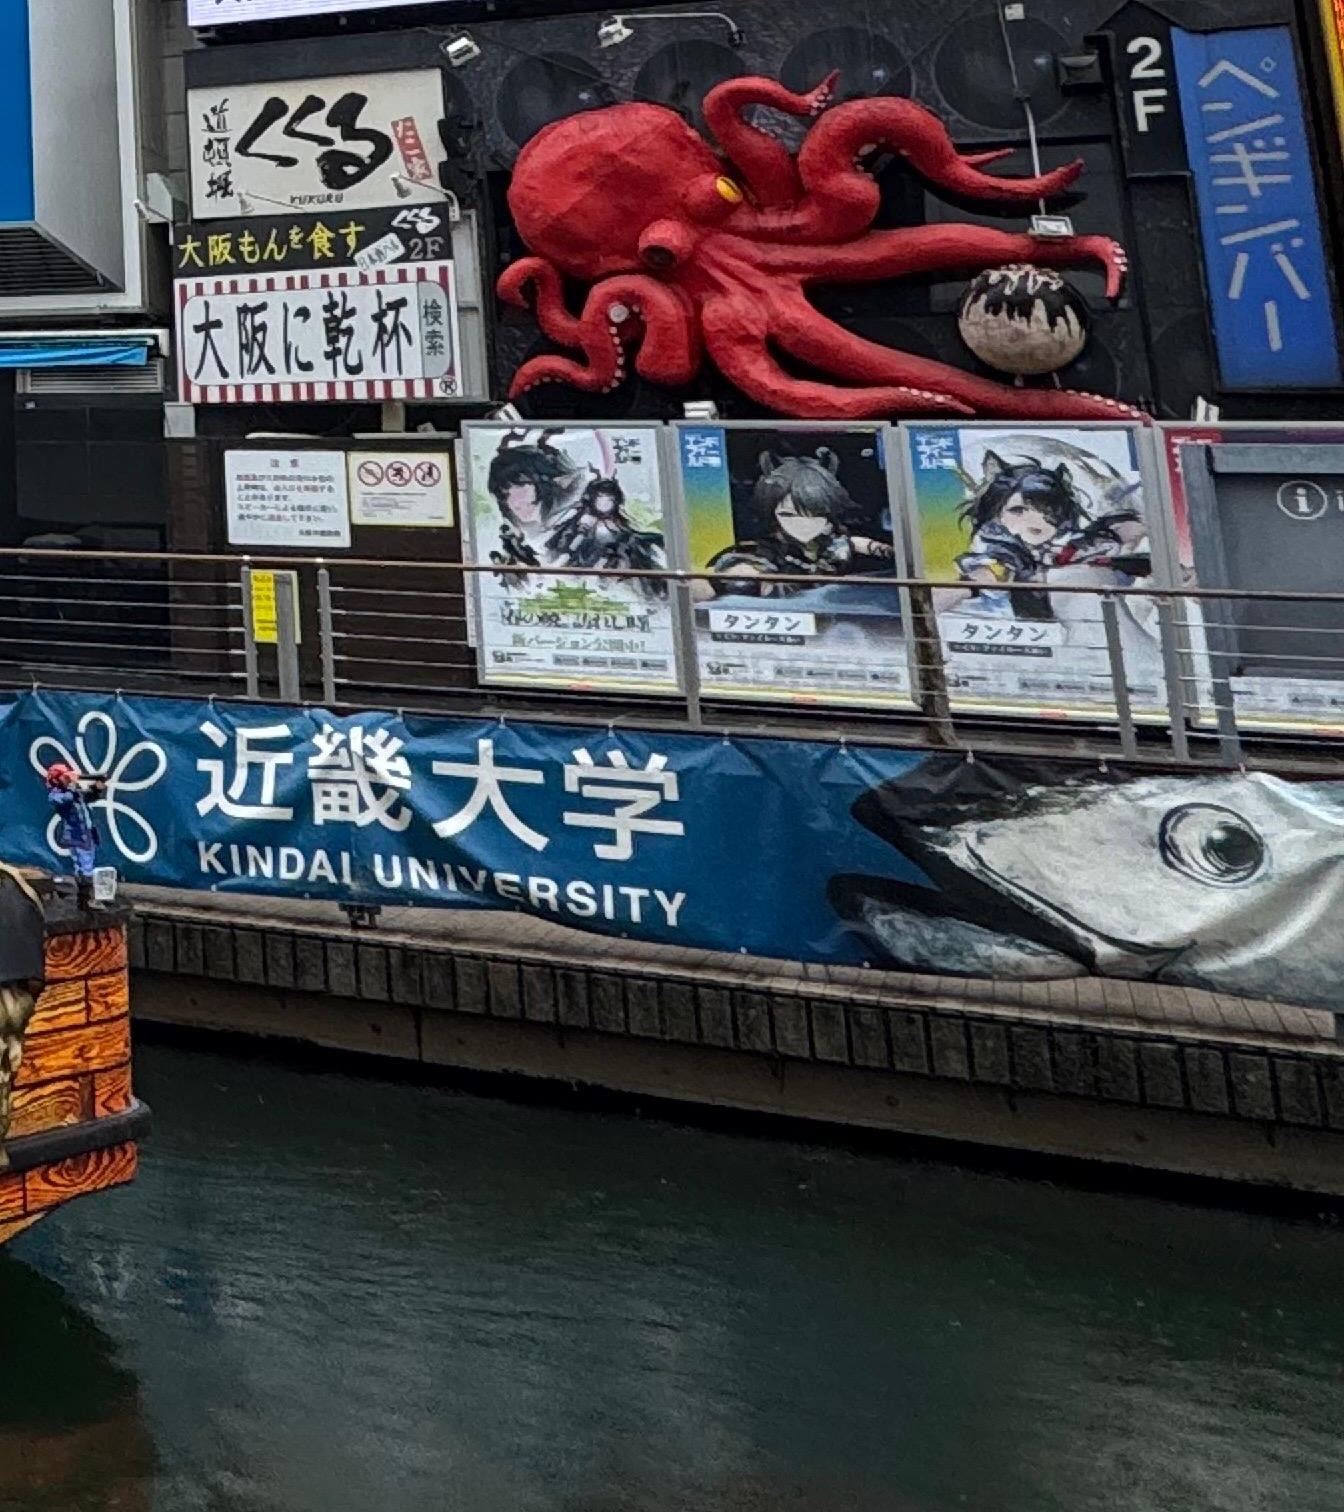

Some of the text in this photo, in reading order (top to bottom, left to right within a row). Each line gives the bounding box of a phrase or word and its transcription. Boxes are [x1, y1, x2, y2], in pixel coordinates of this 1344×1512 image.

[1125, 36, 1170, 133] 2F
[234, 92, 395, 191] くくる
[178, 221, 367, 270] 大阪もんを食す
[390, 206, 442, 235] くくる
[409, 235, 446, 261] 2F
[1197, 56, 1312, 354] ペンギンバー
[192, 289, 414, 380] 大阪に乾杯
[723, 613, 802, 632] タンタン
[194, 719, 686, 863] 近畿大学
[198, 839, 691, 930] KINDAI UNIVERSITY
